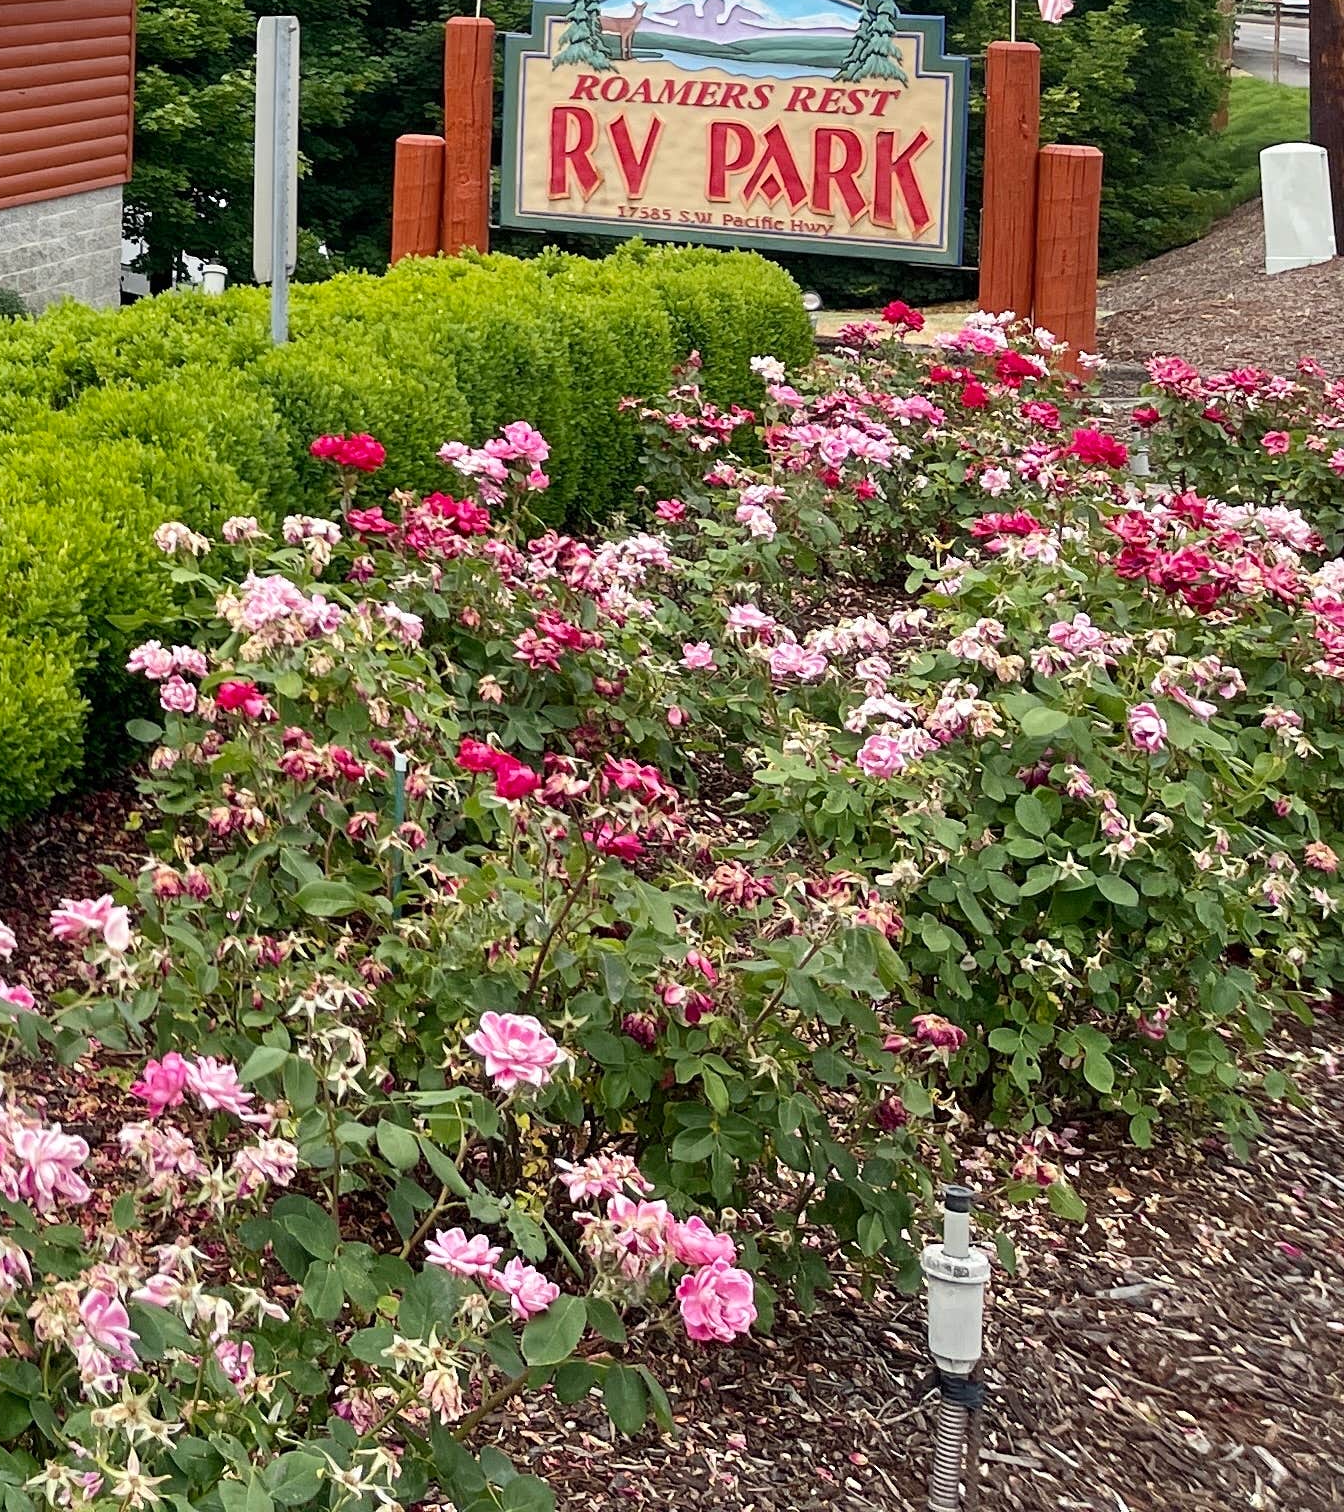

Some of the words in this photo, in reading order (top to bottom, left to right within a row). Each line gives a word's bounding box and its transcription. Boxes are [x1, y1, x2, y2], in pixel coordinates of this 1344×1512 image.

[569, 73, 776, 111] ROAMERS
[784, 85, 902, 117] REST
[548, 102, 666, 203] RV
[705, 119, 936, 239] PARK
[617, 205, 673, 221] 17585
[722, 213, 785, 231] Pacific
[790, 219, 835, 236] Hwy
